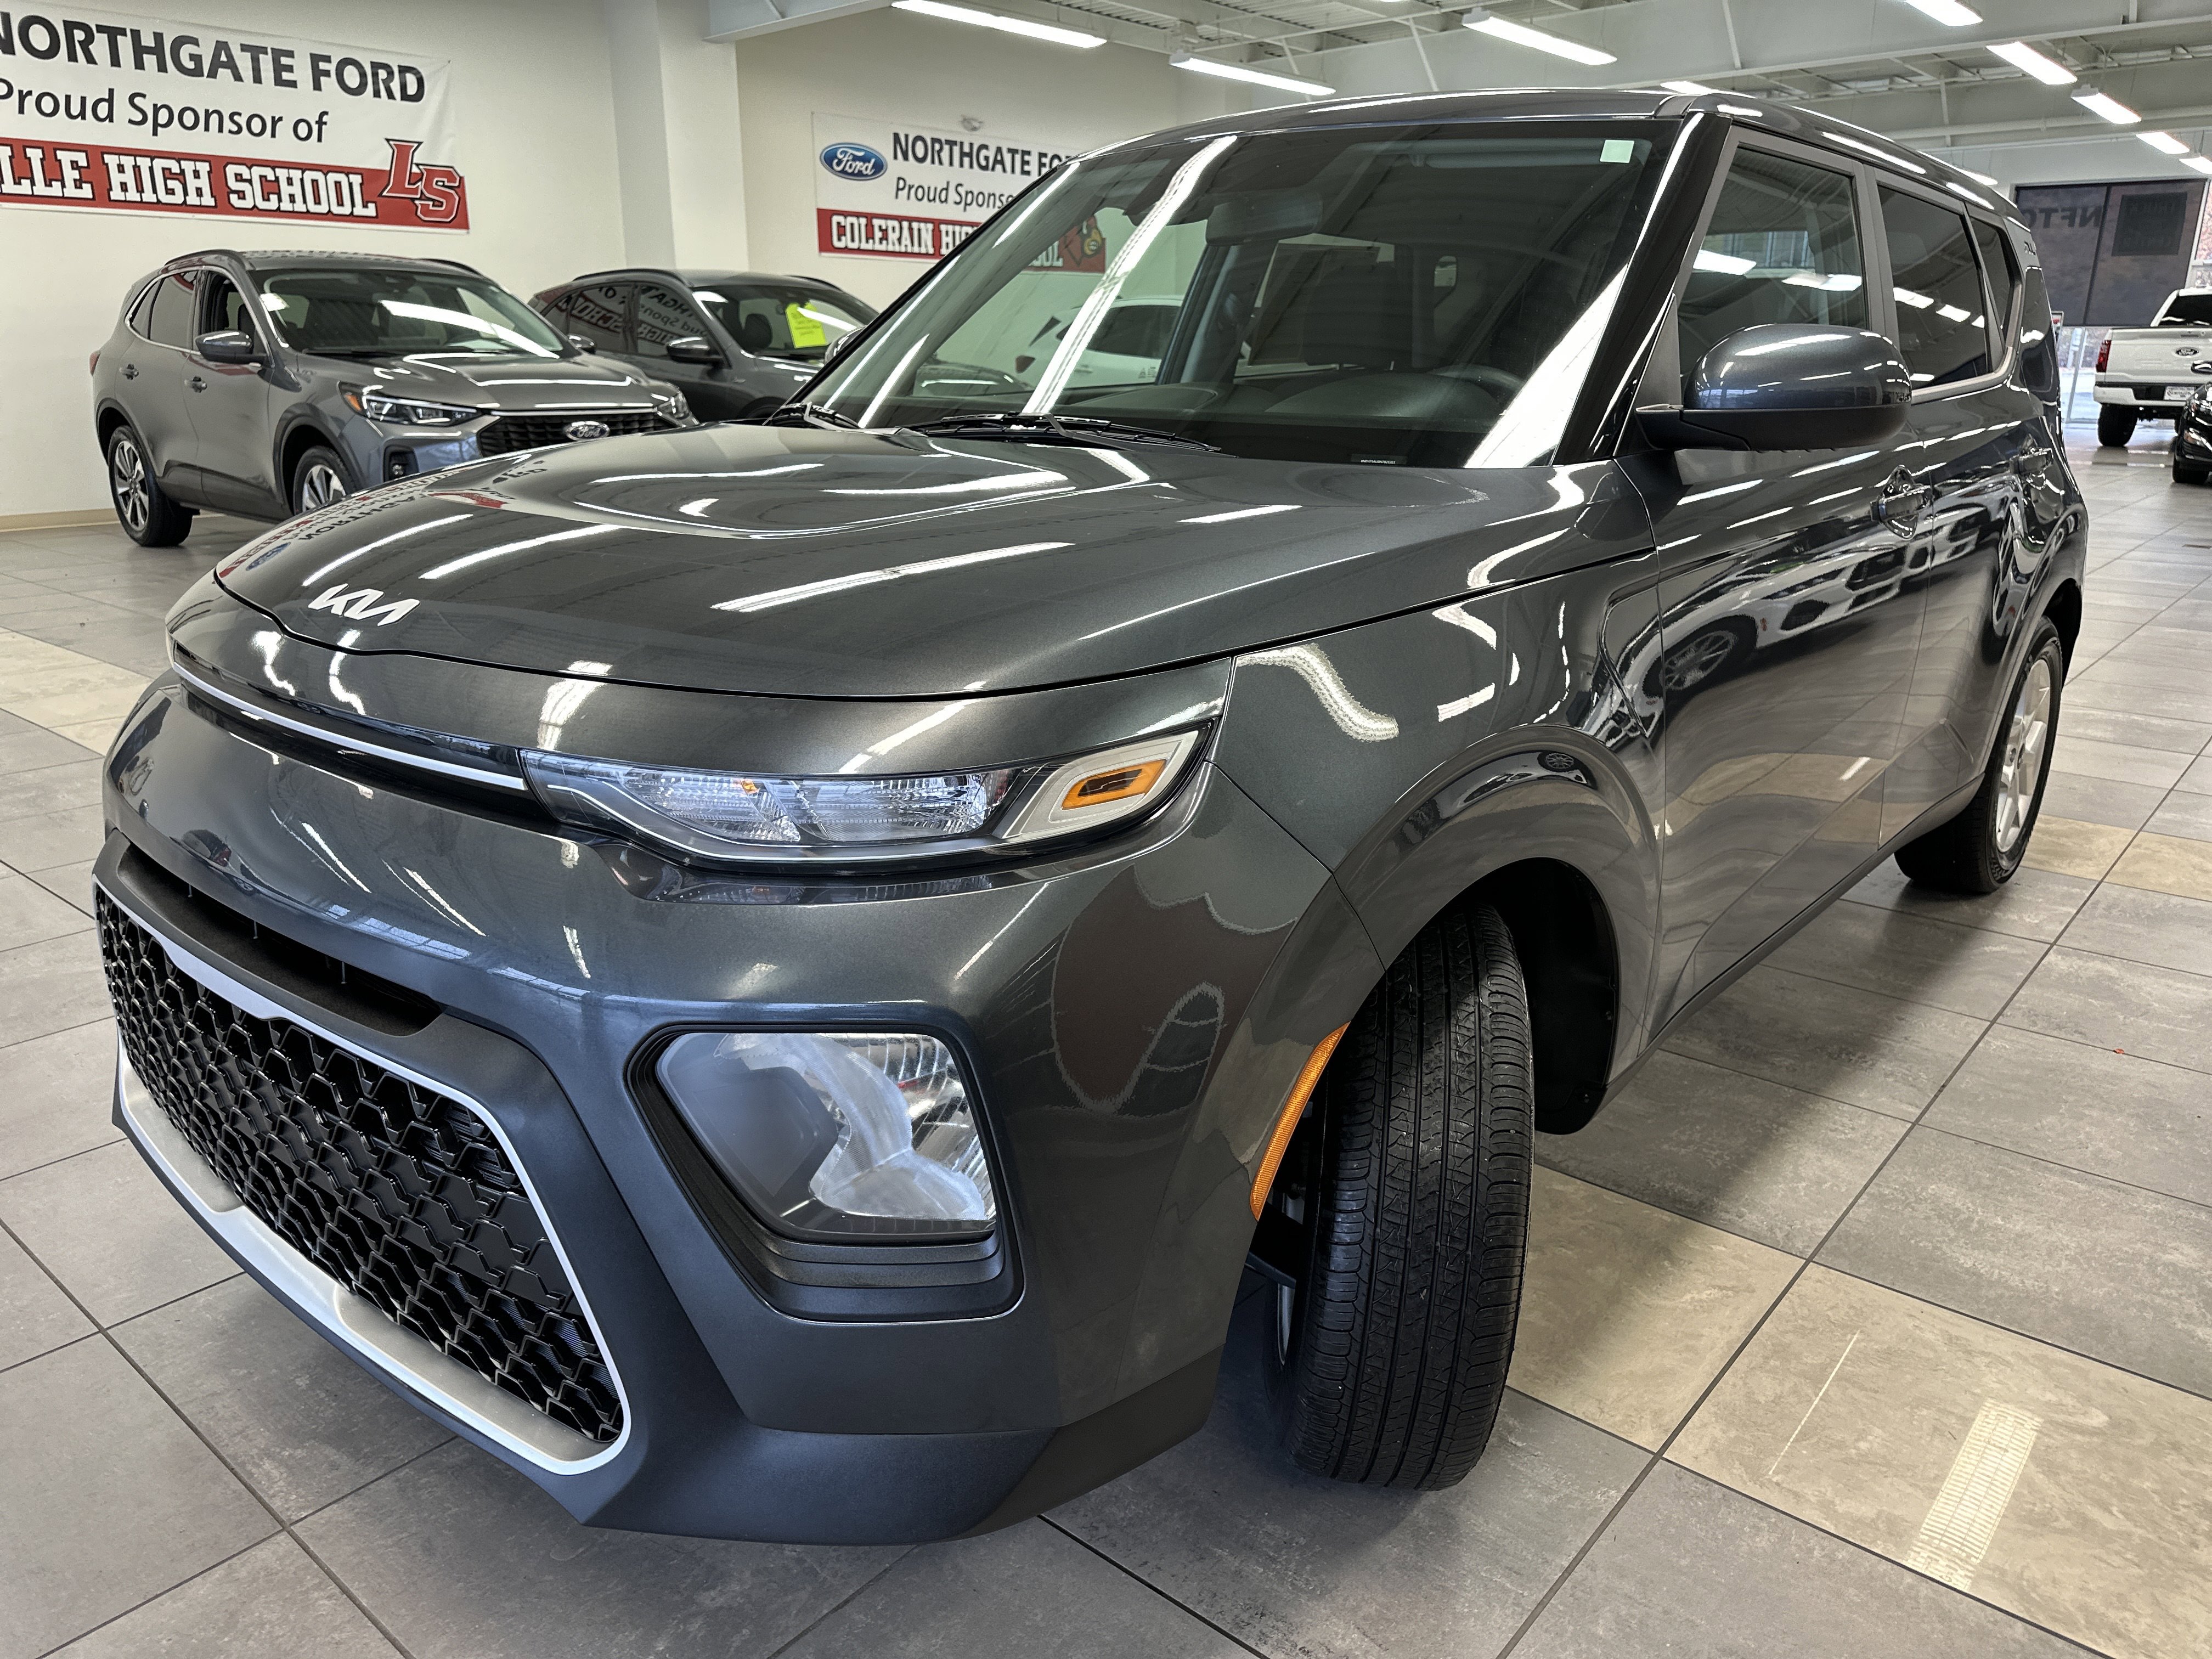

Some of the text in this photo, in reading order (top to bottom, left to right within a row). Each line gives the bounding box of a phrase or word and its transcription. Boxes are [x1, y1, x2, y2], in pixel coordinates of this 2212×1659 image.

[309, 53, 426, 103] FORD
[127, 92, 283, 138] Sponsor
[292, 111, 329, 143] of
[832, 148, 876, 176] Ford
[892, 132, 1031, 176] NORTHGATE
[103, 151, 216, 207] HIGH
[224, 162, 377, 218] SCHOOL
[895, 177, 950, 204] Proud
[830, 215, 935, 255] COLERAIN
